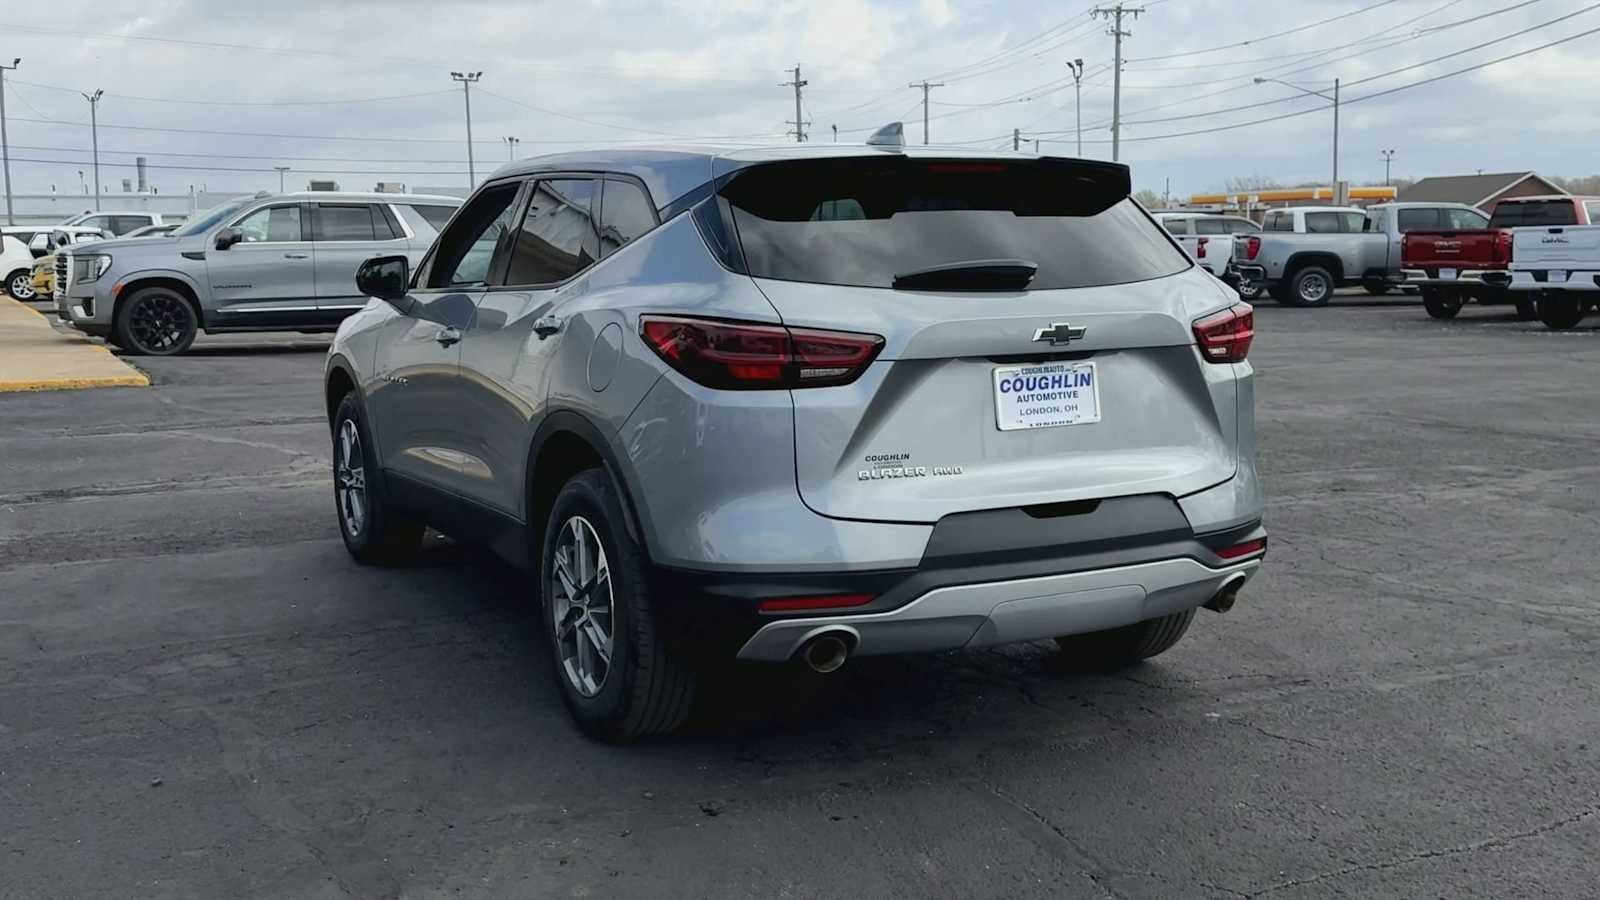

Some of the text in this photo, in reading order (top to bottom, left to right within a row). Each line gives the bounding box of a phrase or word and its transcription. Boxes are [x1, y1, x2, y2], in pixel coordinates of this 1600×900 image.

[1000, 373, 1091, 393] COUGHLIN
[1016, 390, 1079, 403] AUTOMOTIVE
[1020, 404, 1078, 417] LONDON, OH
[865, 453, 910, 462] COUGHLIN
[857, 466, 963, 481] BLAZER AWD
